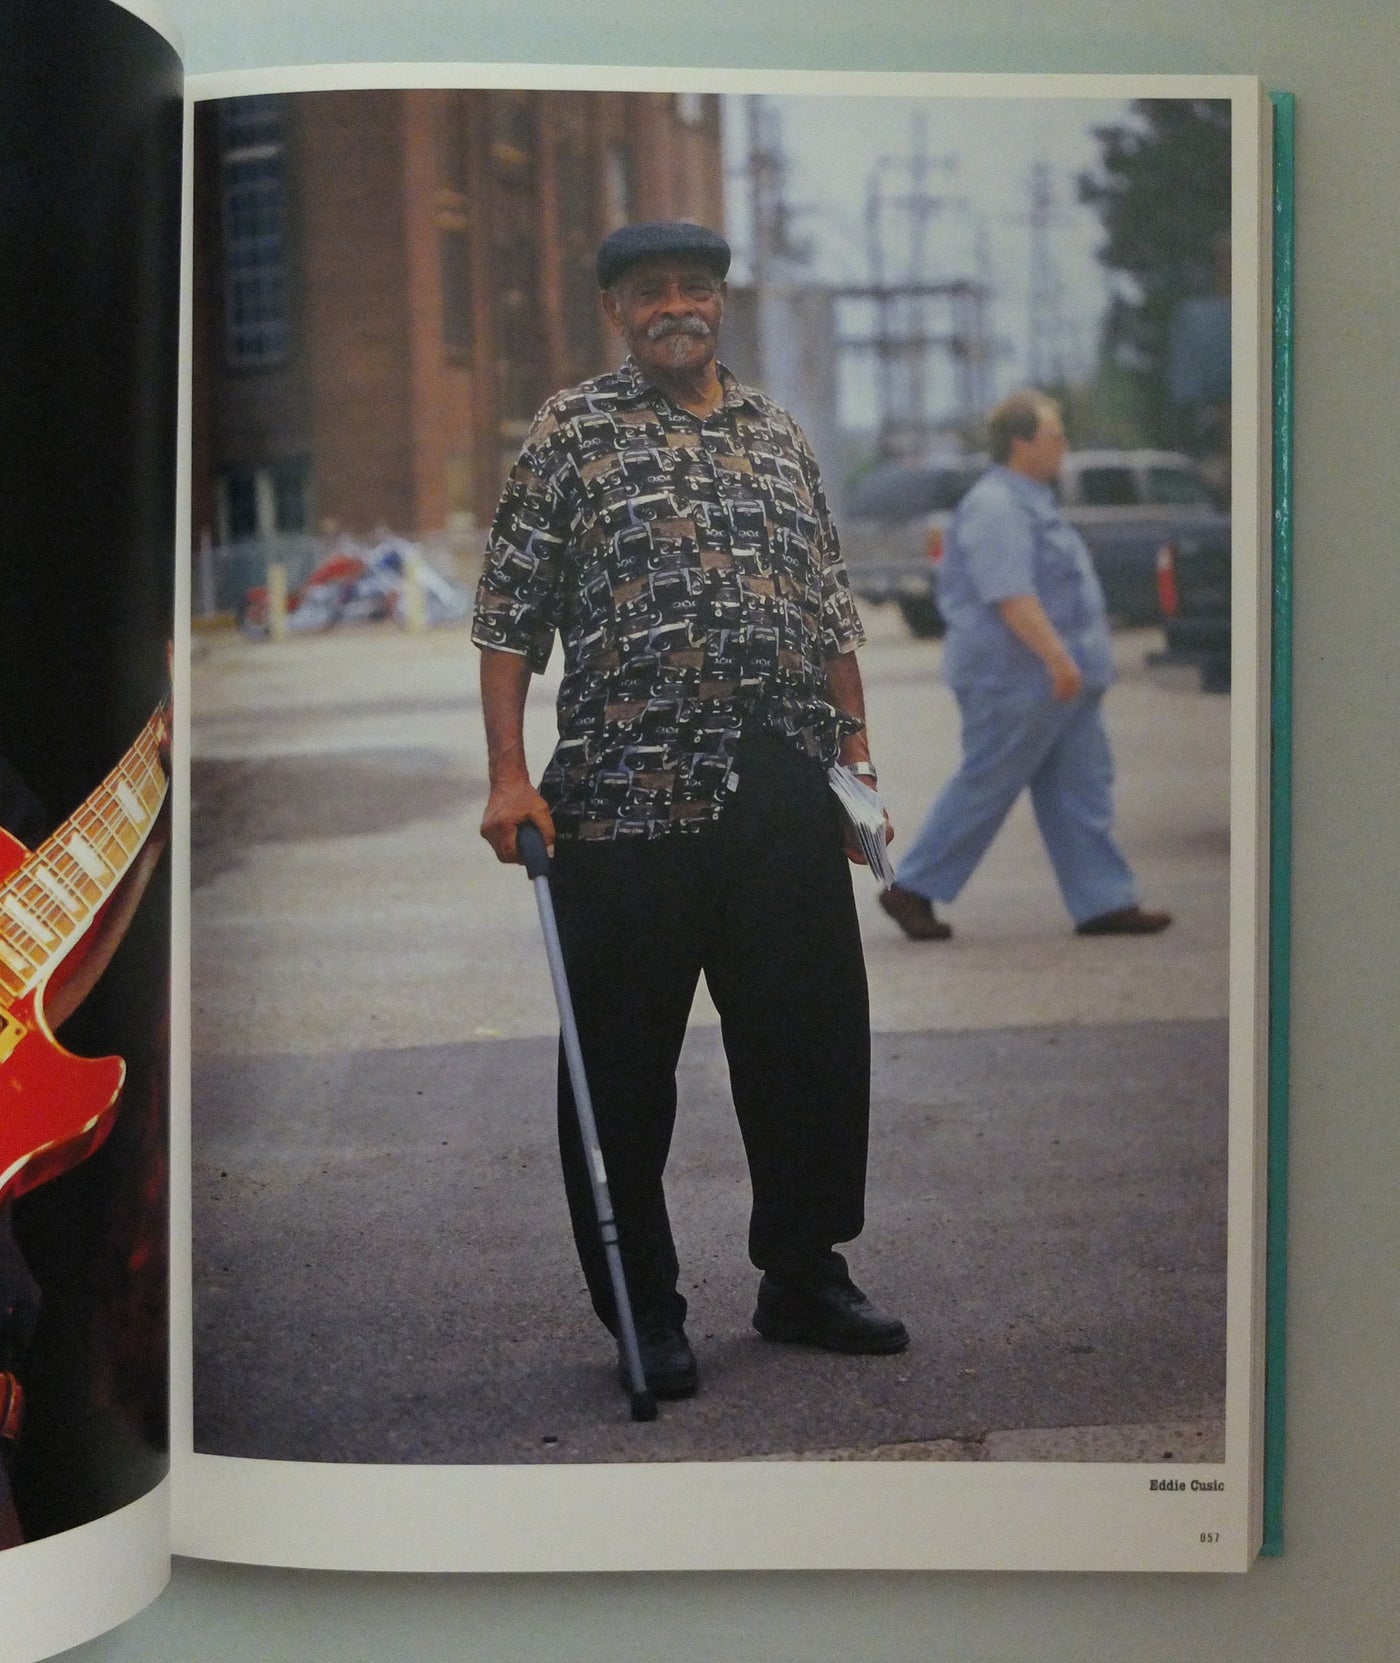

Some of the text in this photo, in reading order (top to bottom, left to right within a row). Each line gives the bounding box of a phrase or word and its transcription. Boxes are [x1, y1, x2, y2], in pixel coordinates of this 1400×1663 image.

[1149, 1479, 1225, 1491] Eddie Cusic
[1200, 1532, 1220, 1543] 057
